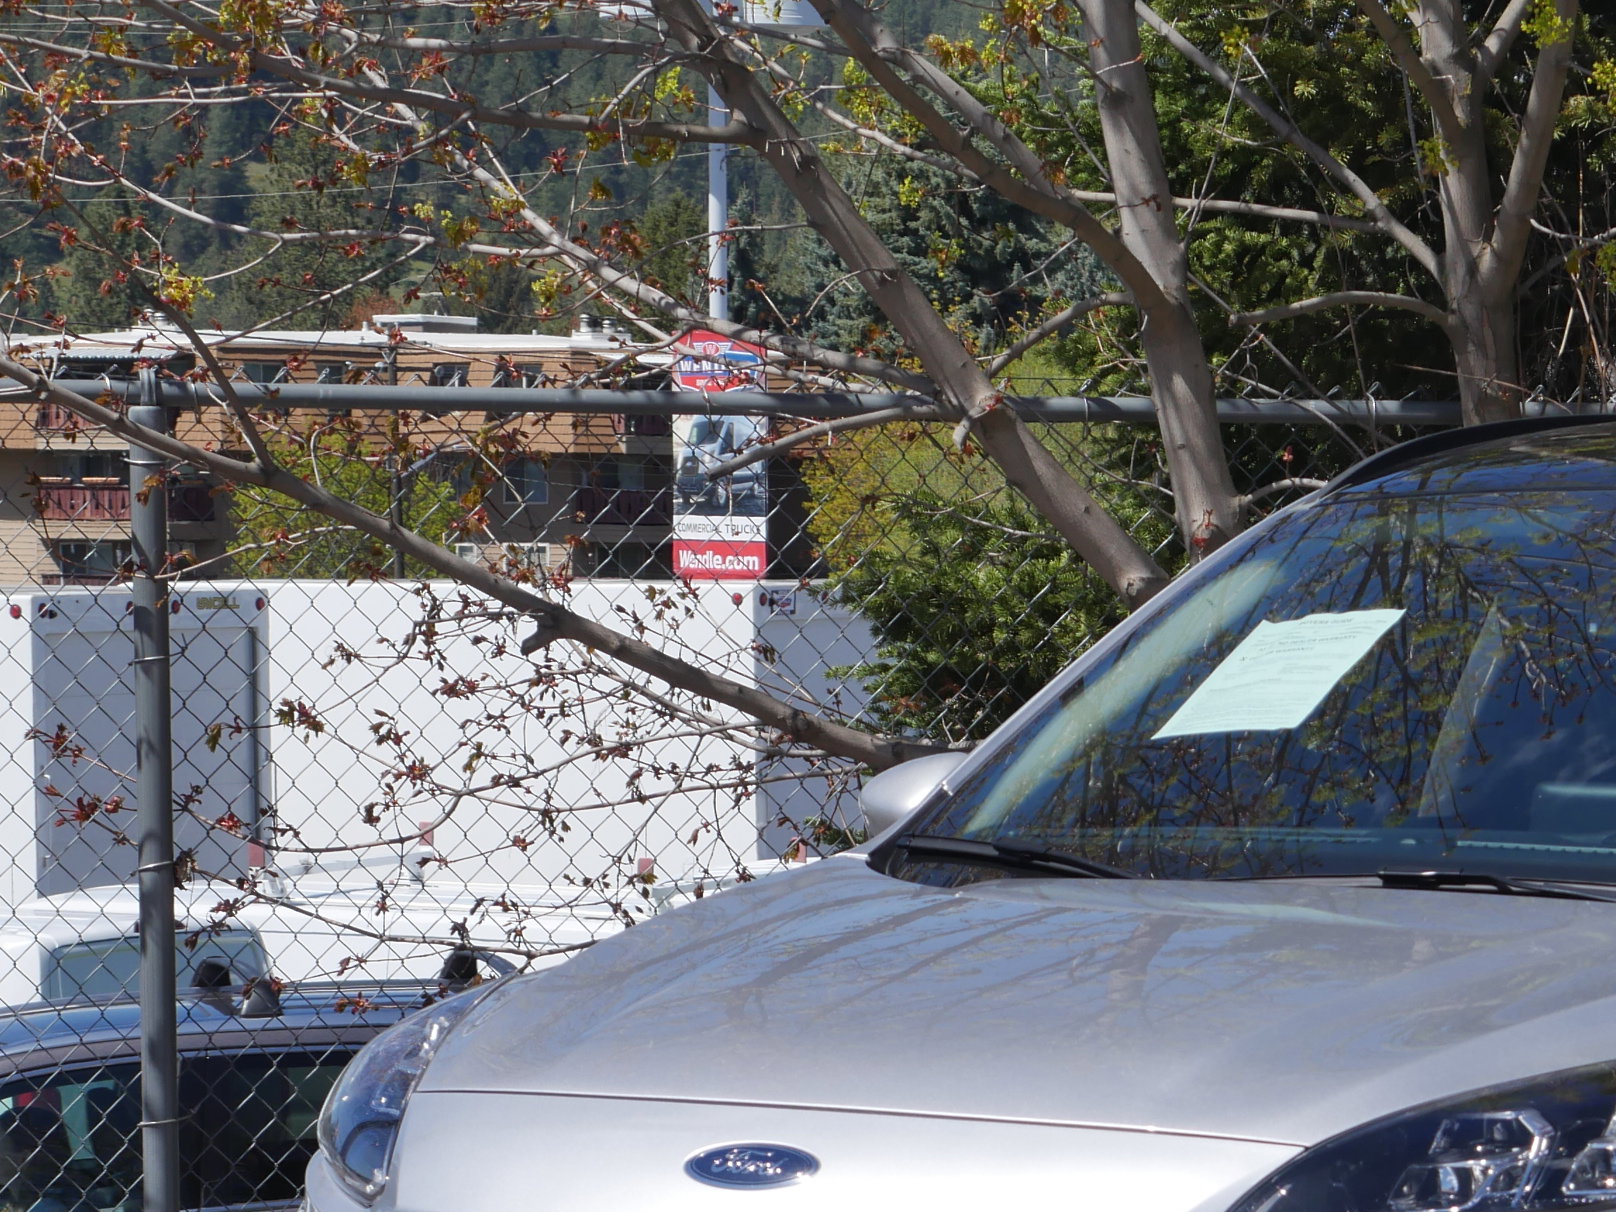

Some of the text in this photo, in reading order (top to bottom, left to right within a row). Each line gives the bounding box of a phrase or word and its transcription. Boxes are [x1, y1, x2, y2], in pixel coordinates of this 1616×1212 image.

[725, 523, 760, 535] TRUCK
[679, 550, 759, 570] Wendle.com
[710, 1149, 789, 1176] Ford
